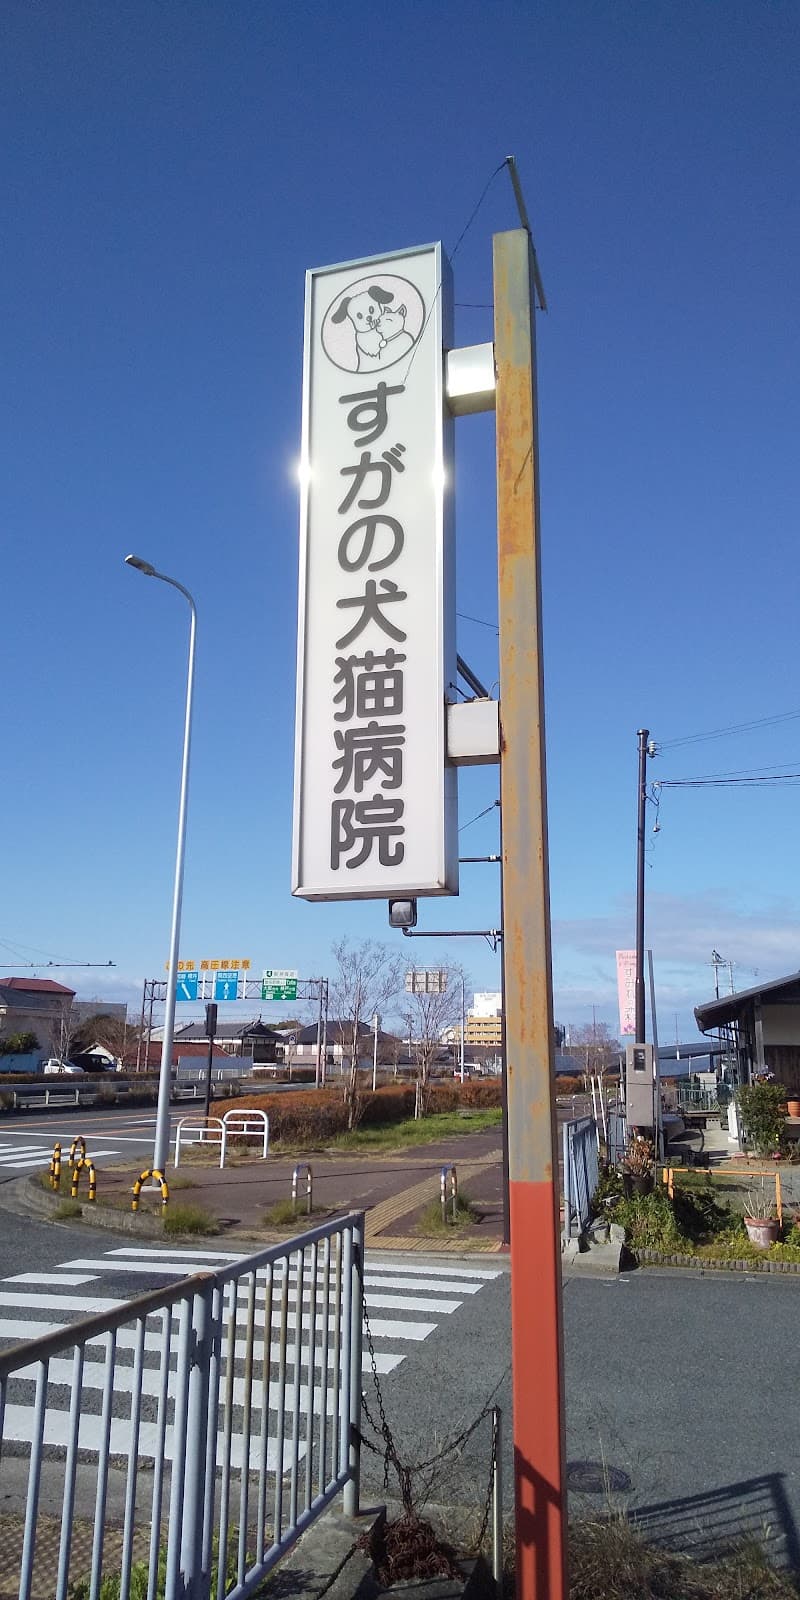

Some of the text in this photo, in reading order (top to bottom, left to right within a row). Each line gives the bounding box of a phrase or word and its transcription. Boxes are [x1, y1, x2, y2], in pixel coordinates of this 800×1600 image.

[330, 381, 408, 871] すがの犬猫病院
